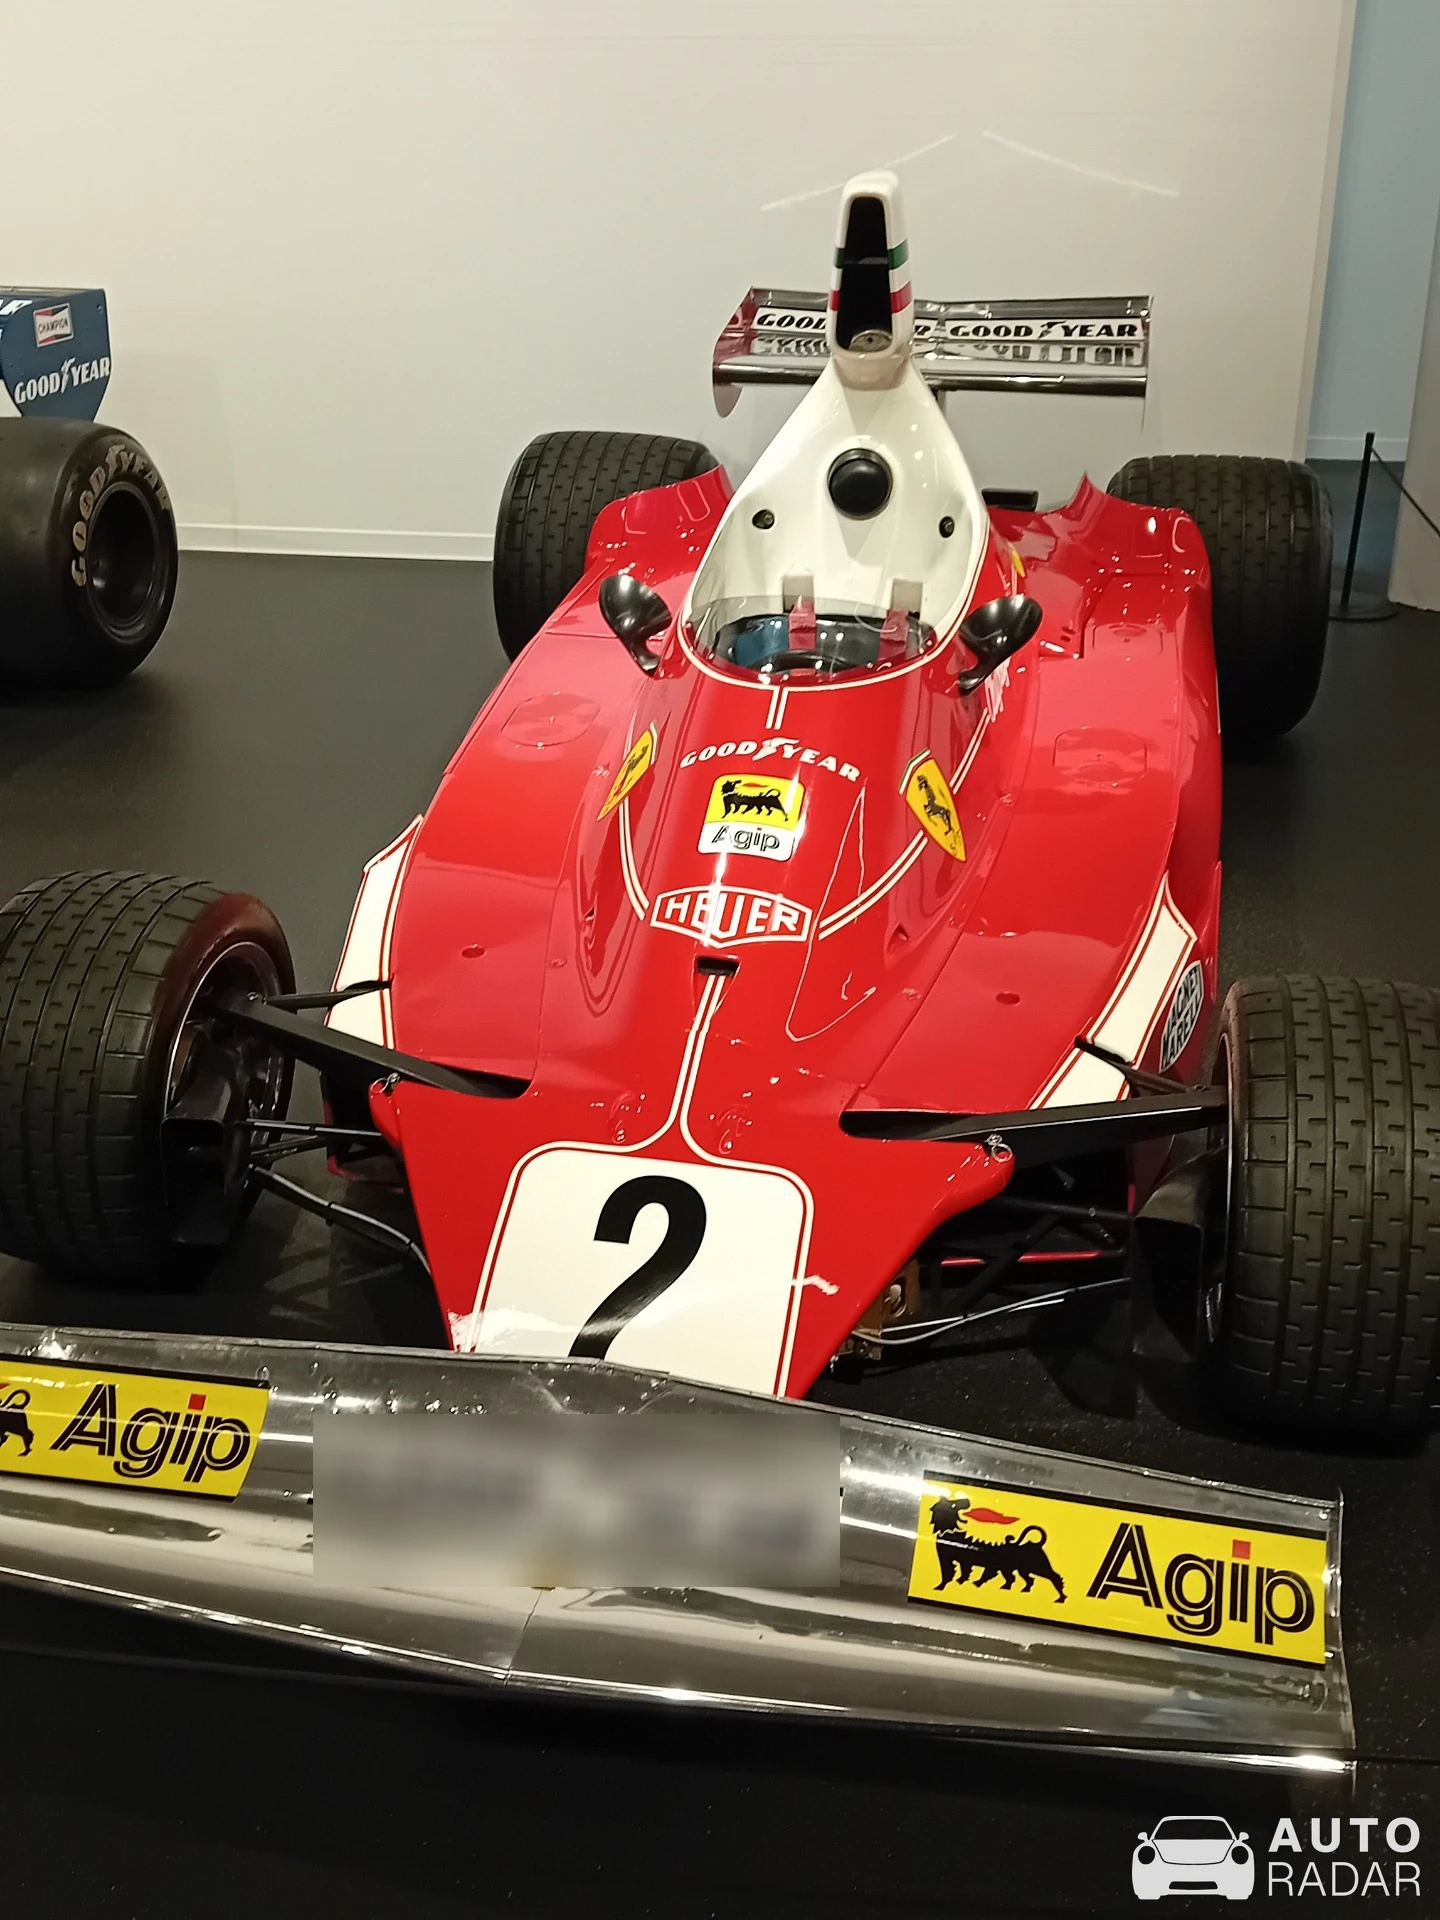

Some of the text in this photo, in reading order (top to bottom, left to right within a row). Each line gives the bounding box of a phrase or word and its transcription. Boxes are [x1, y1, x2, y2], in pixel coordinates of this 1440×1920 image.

[38, 318, 69, 334] CHAMPION
[710, 825, 781, 852] Agip
[664, 891, 800, 940] HEUER
[567, 1174, 707, 1361] 2
[50, 1383, 250, 1483] Agip
[1086, 1522, 1315, 1646] Agip
